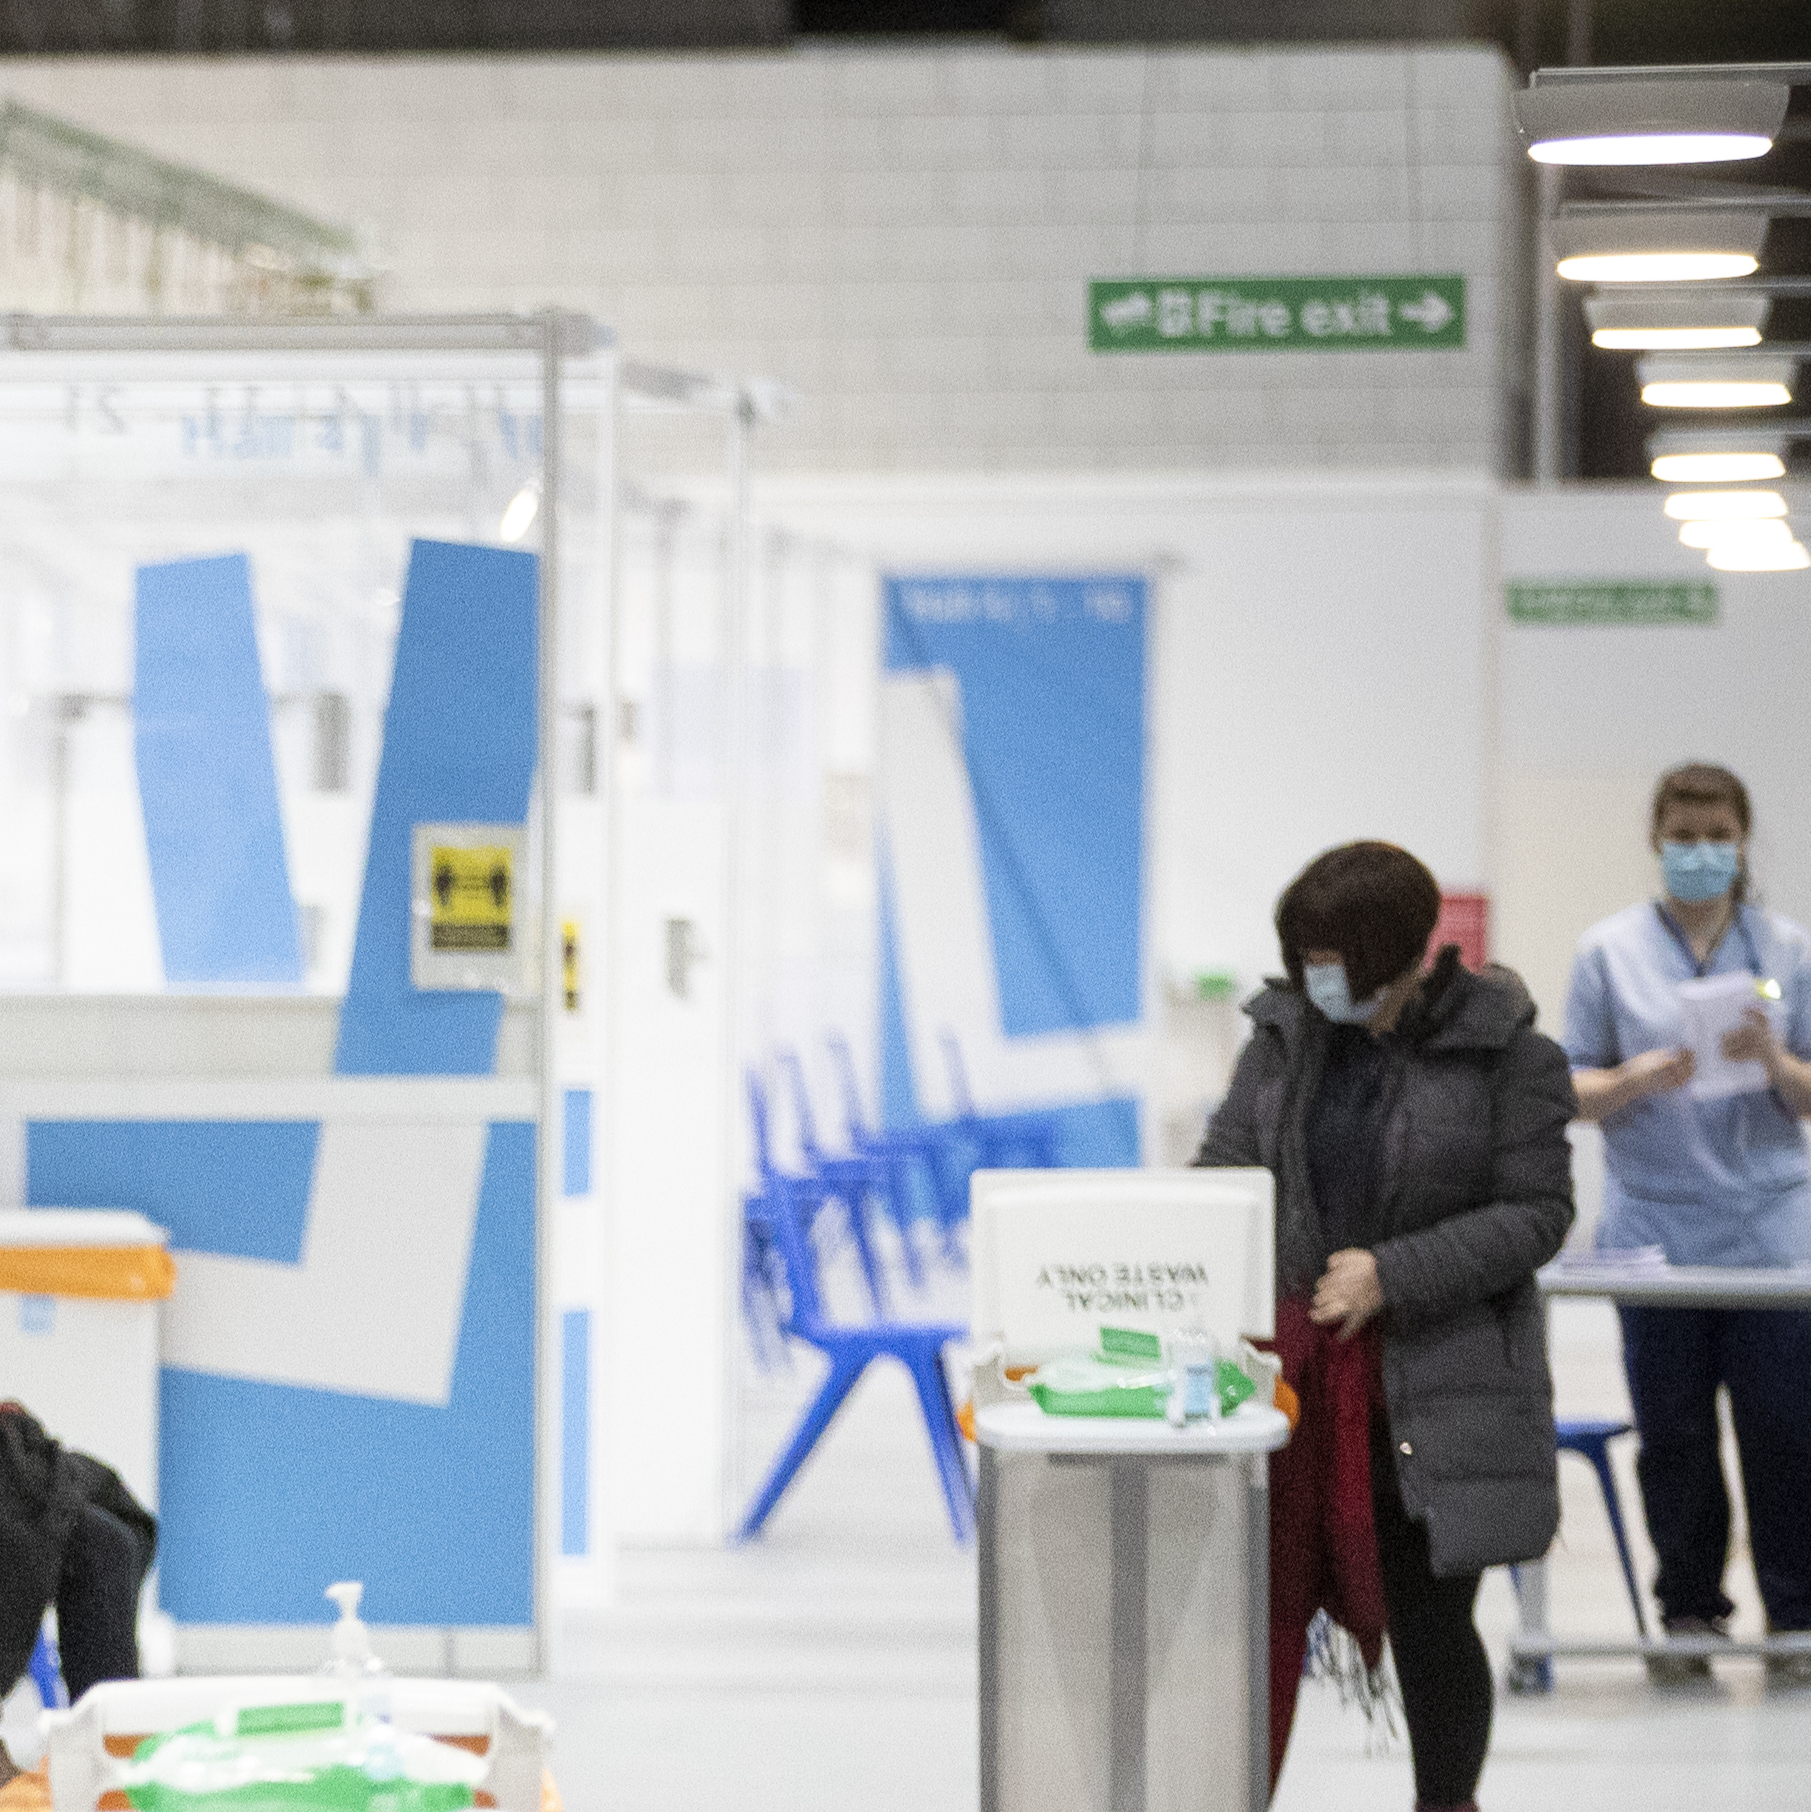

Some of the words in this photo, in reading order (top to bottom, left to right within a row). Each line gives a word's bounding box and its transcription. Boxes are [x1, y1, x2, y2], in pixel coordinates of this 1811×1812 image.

[1198, 288, 1291, 338] Fire
[1300, 288, 1391, 338] exit
[1036, 1263, 1107, 1289] ONLY
[1114, 1263, 1209, 1288] WASTE
[1063, 1289, 1185, 1313] CLINICAL
